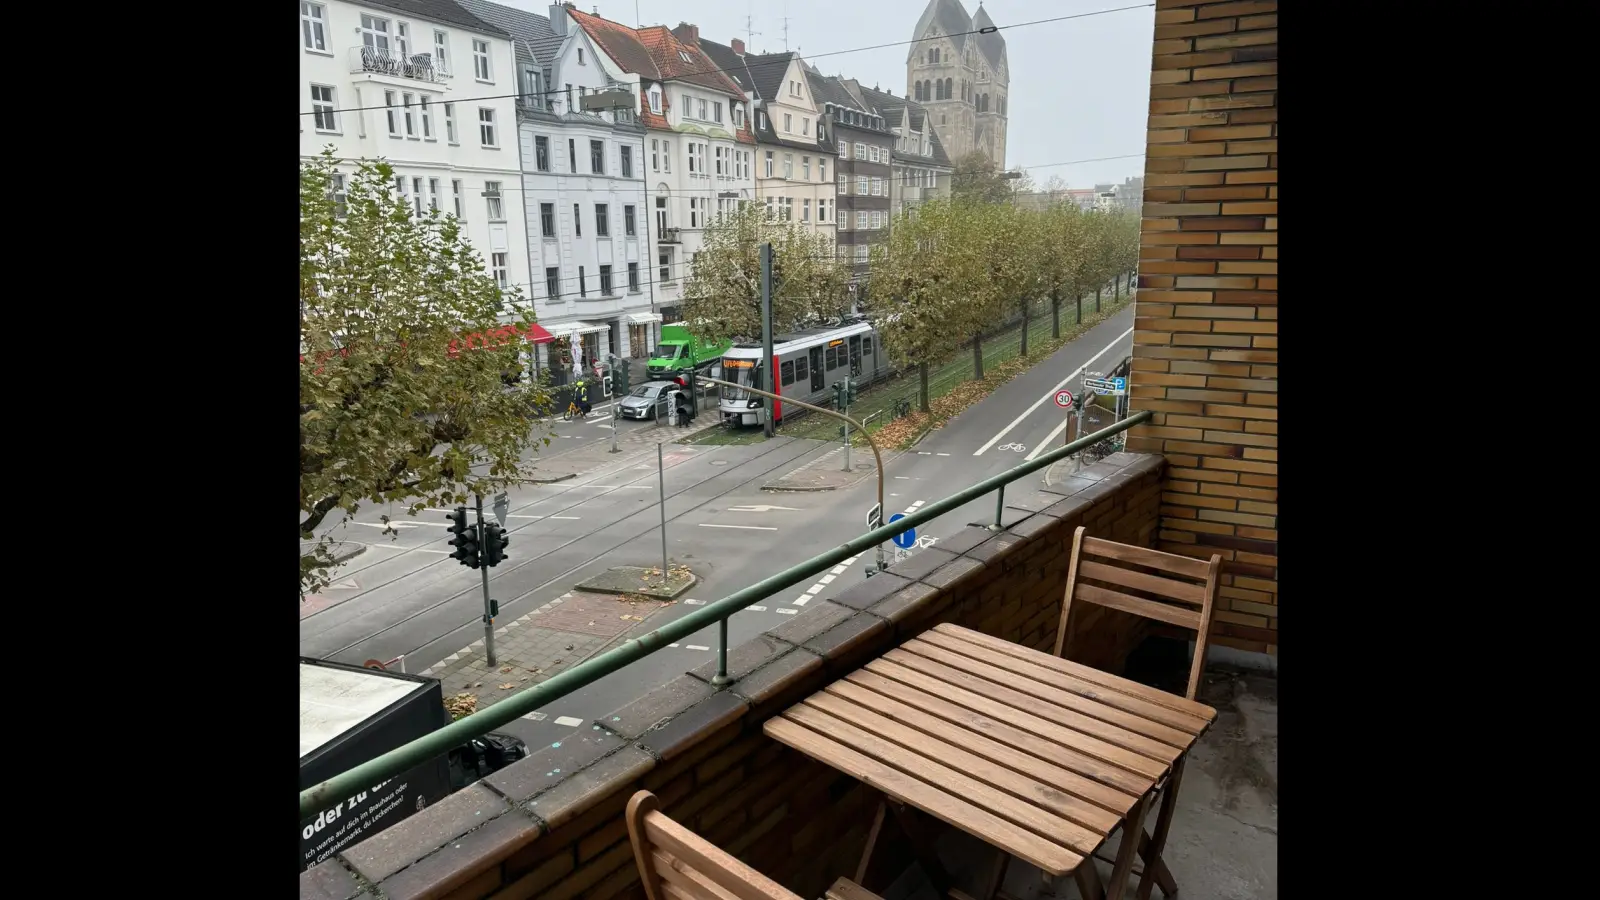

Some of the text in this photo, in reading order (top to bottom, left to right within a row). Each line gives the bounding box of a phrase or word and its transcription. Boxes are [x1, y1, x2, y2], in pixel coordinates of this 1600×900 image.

[1059, 395, 1070, 403] 30
[302, 791, 367, 840] oder zu
[305, 849, 315, 859] Ich
[316, 836, 334, 851] warte
[336, 825, 346, 838] auf
[346, 817, 359, 830] dich
[360, 811, 368, 820] im
[369, 792, 395, 814] Brauhaus
[395, 782, 408, 795] oder
[307, 794, 404, 871] im Getränkemarkt, du Leckerchen!
